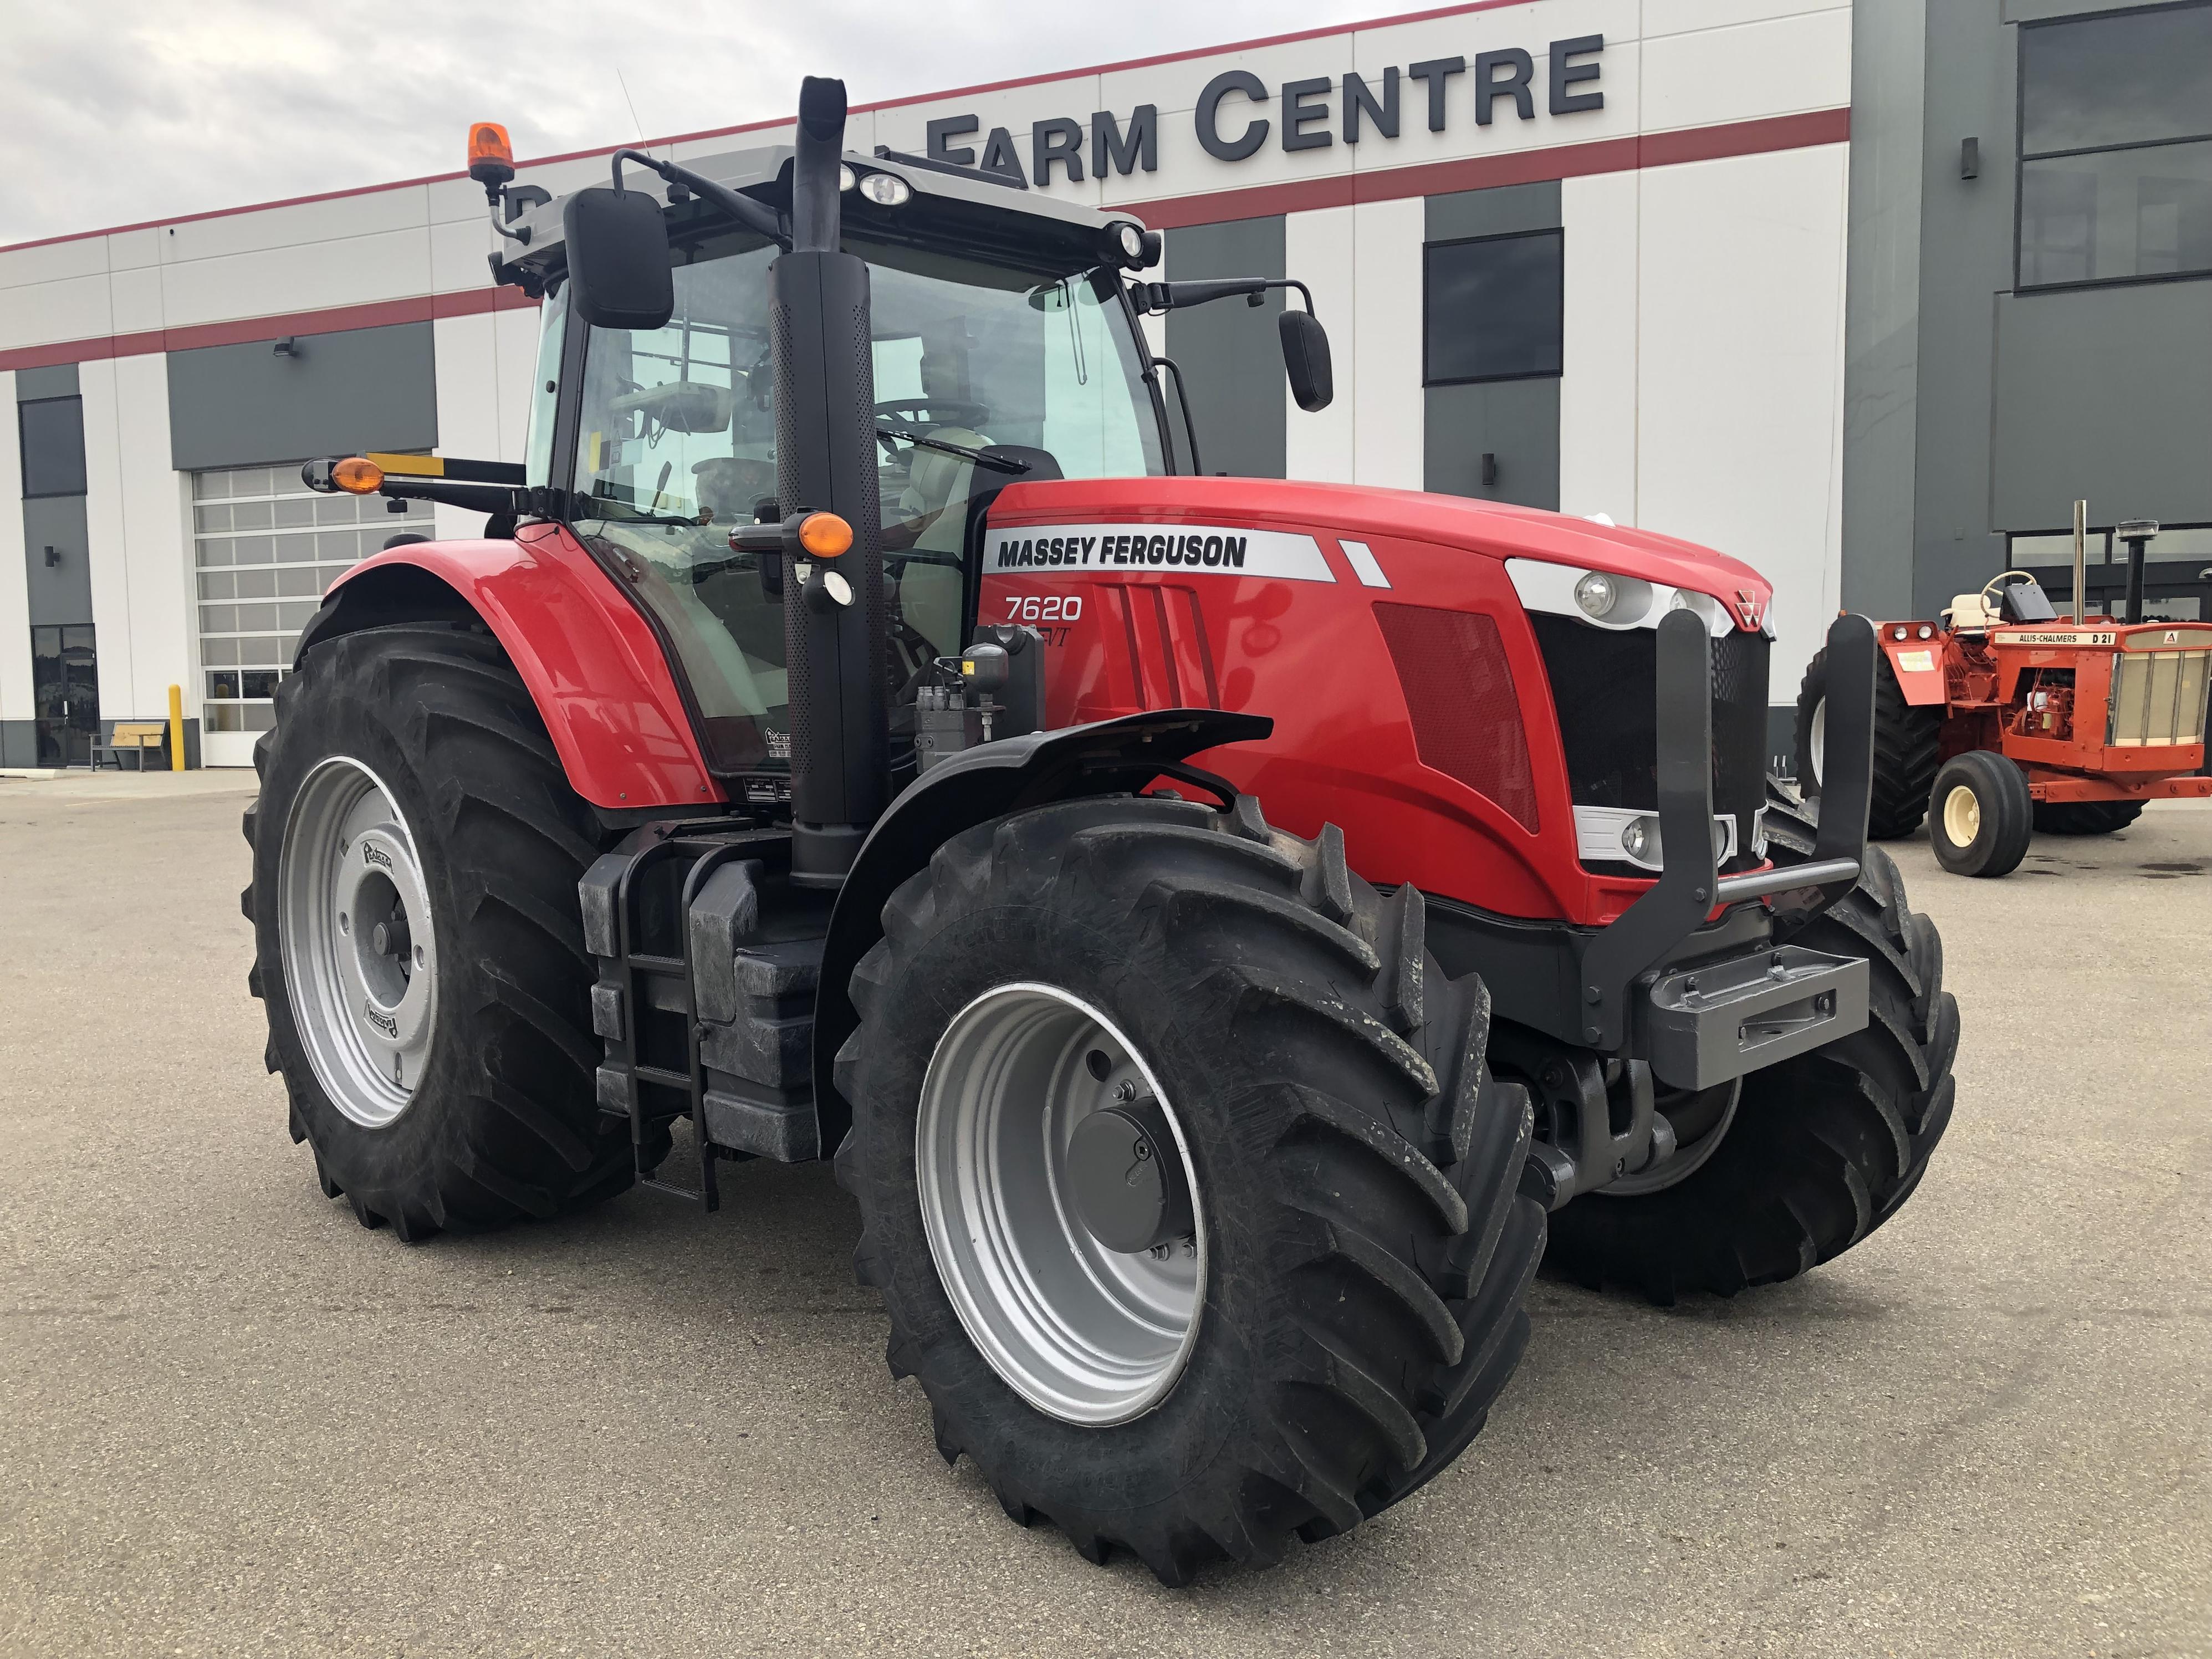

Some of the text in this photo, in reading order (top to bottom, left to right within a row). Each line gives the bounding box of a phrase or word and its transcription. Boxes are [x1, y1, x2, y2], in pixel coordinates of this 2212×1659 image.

[927, 33, 1603, 190] FARM CENTRE
[998, 535, 1247, 568] MASSEY FERGUSON
[1005, 596, 1082, 621] 7620
[2019, 634, 2077, 643] ALLIS-CHALMERS
[2092, 634, 2098, 644] D
[2101, 634, 2111, 644] 21
